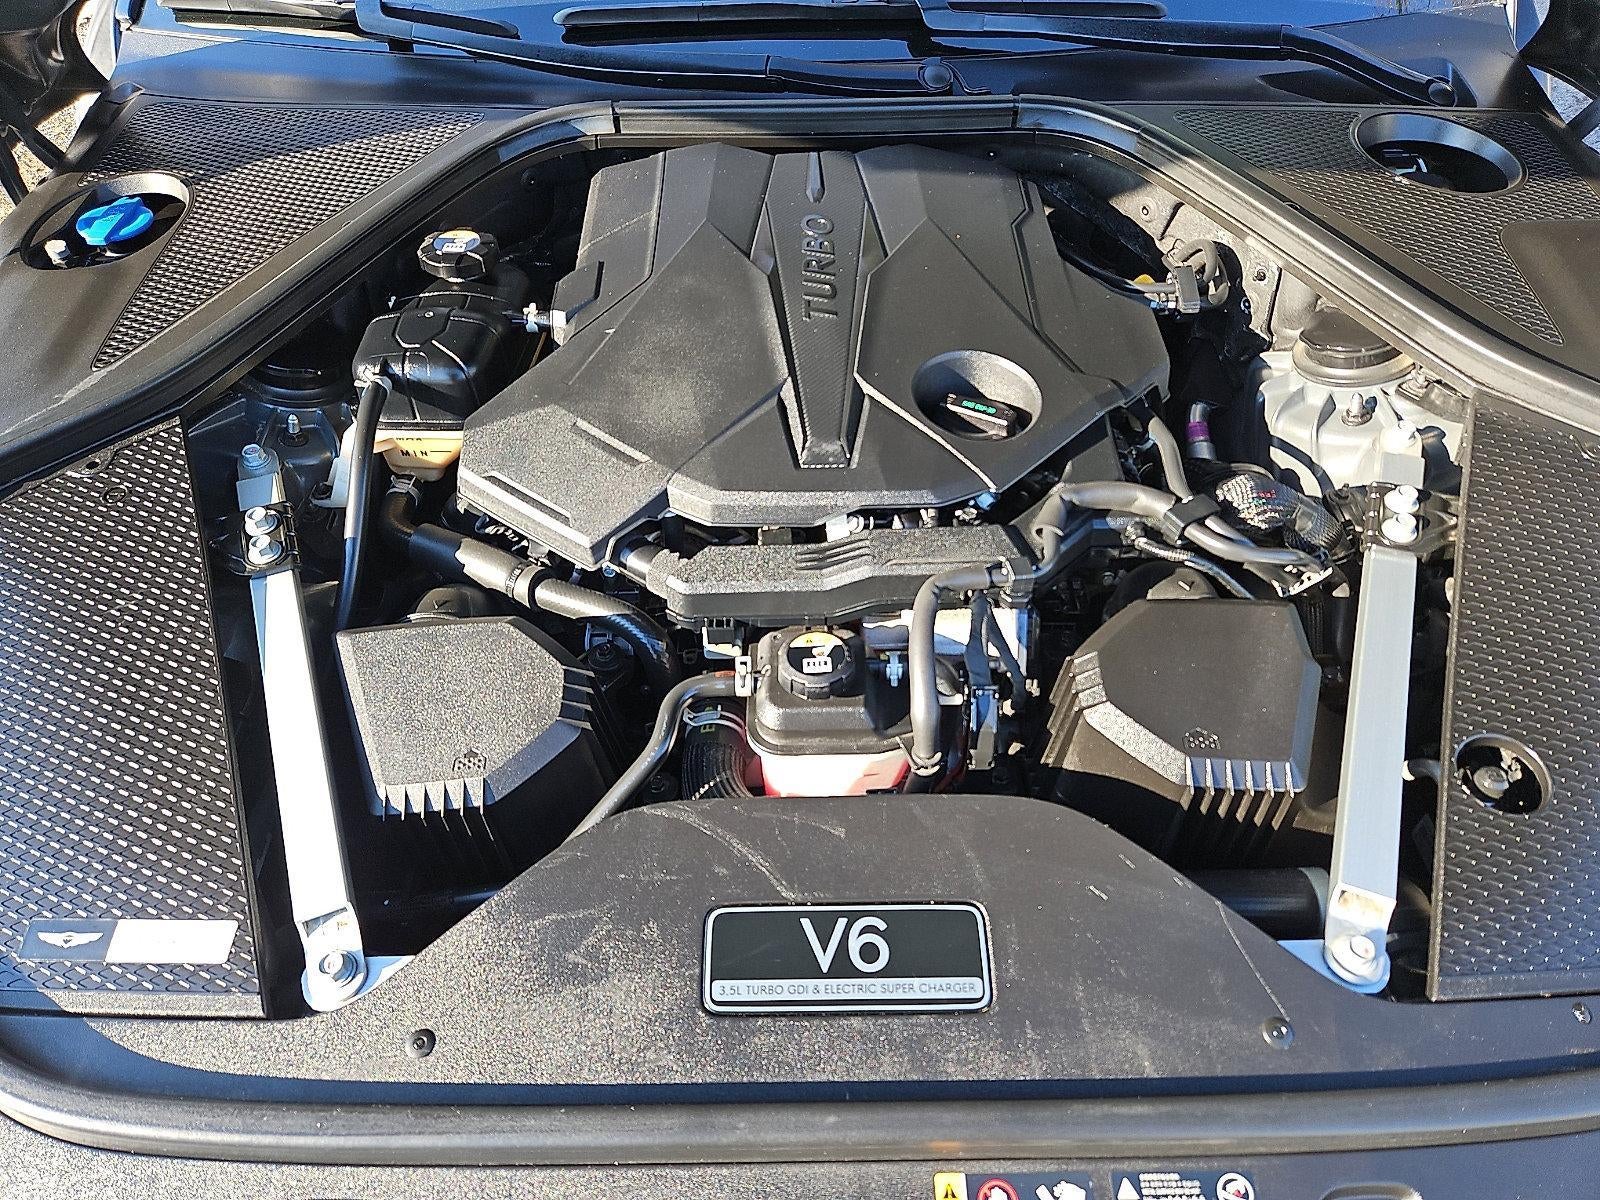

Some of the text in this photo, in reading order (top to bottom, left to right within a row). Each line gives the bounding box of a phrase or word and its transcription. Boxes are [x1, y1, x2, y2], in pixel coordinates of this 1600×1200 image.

[801, 214, 838, 321] TURBO
[400, 449, 428, 457] MIN
[799, 916, 891, 974] V6
[718, 982, 977, 997] 3.5L TURBO GDI & ELECTRIC SUPER CHARGER
